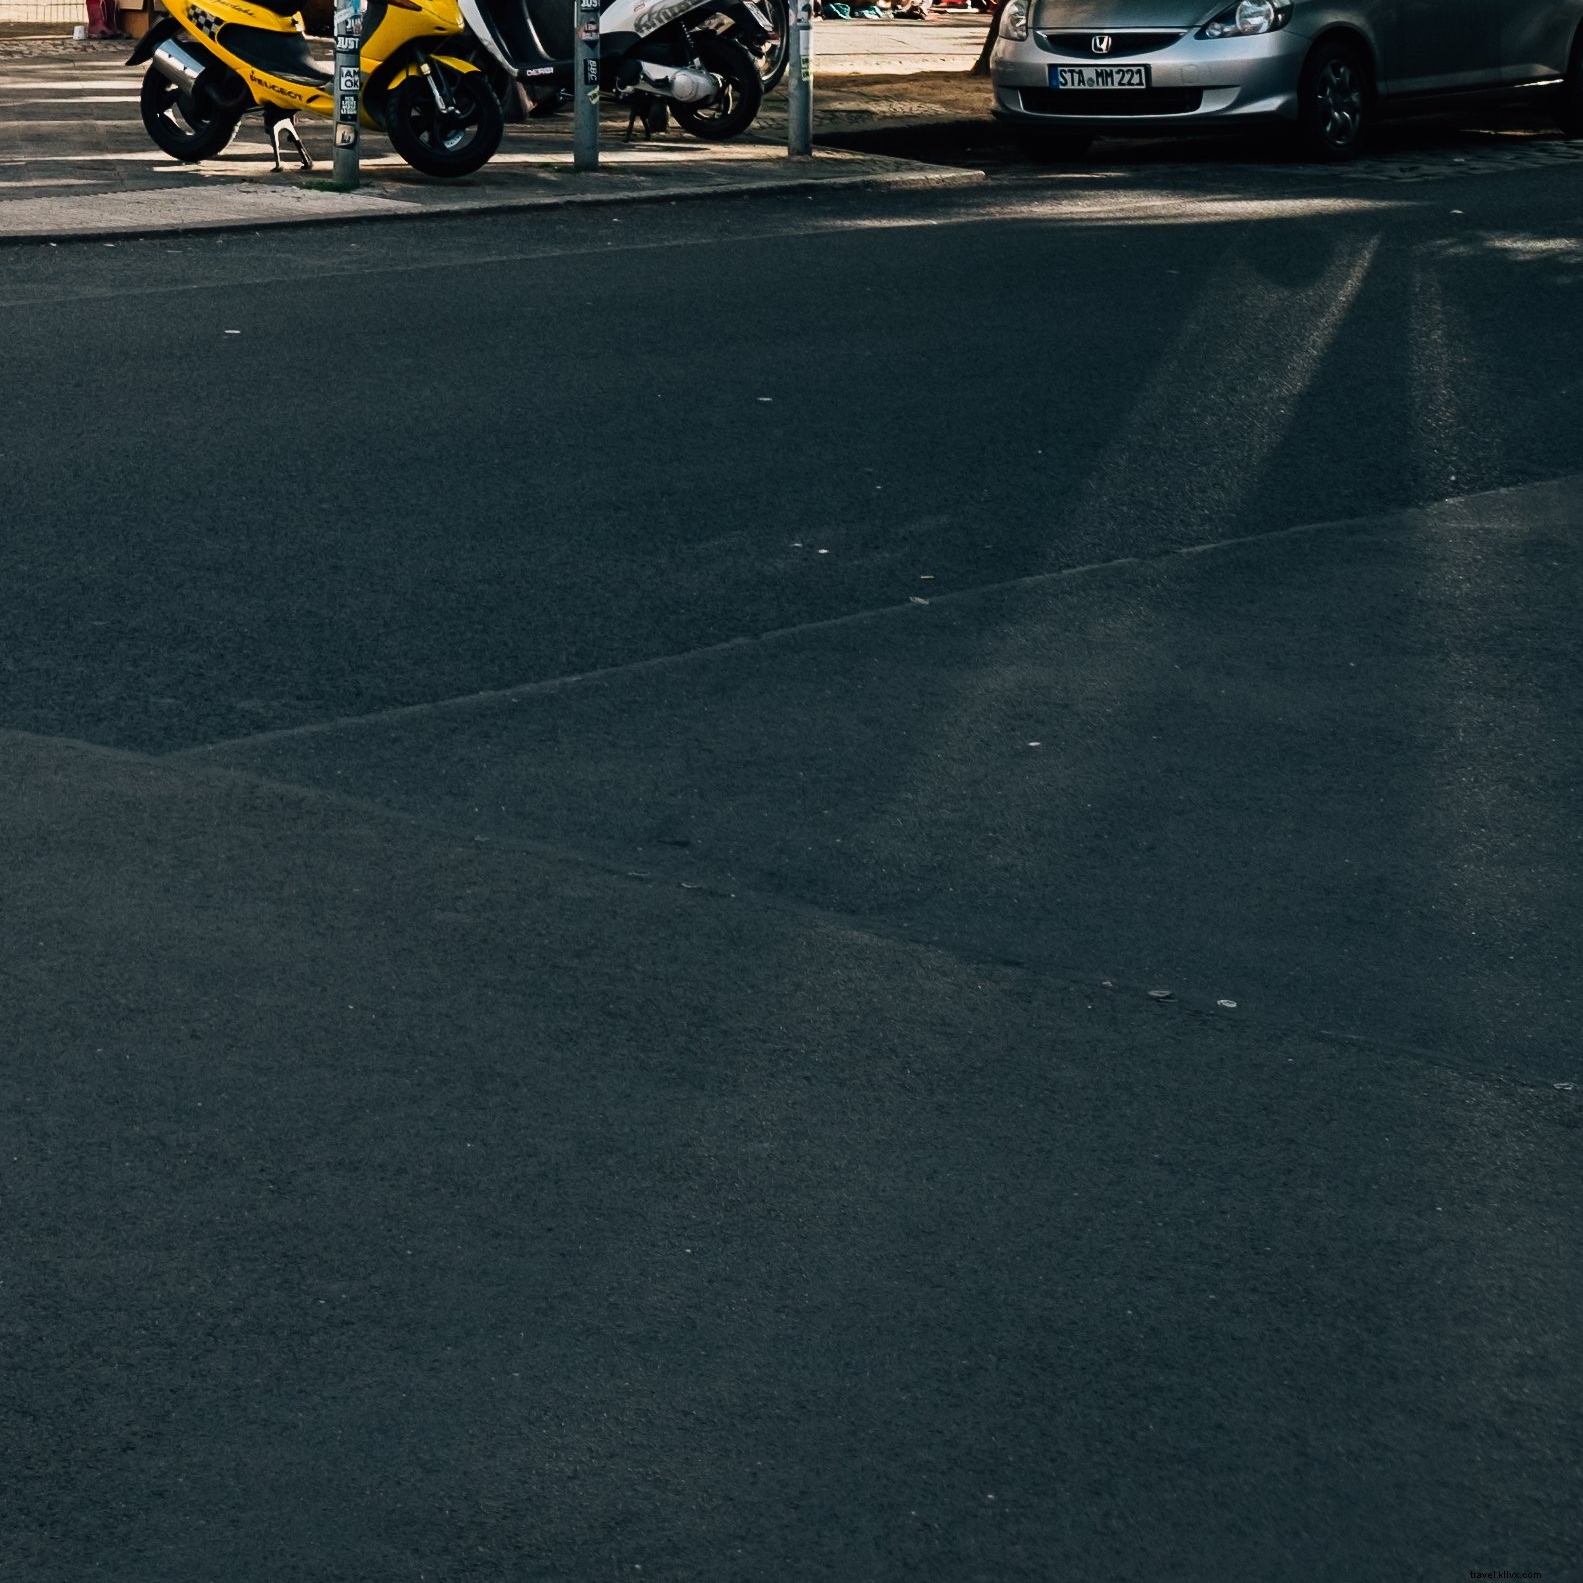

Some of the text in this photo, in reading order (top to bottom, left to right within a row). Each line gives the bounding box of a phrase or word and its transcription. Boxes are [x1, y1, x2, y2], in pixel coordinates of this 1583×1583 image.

[250, 73, 303, 102] PEUGEOT
[1059, 68, 1145, 87] STA MM 221
